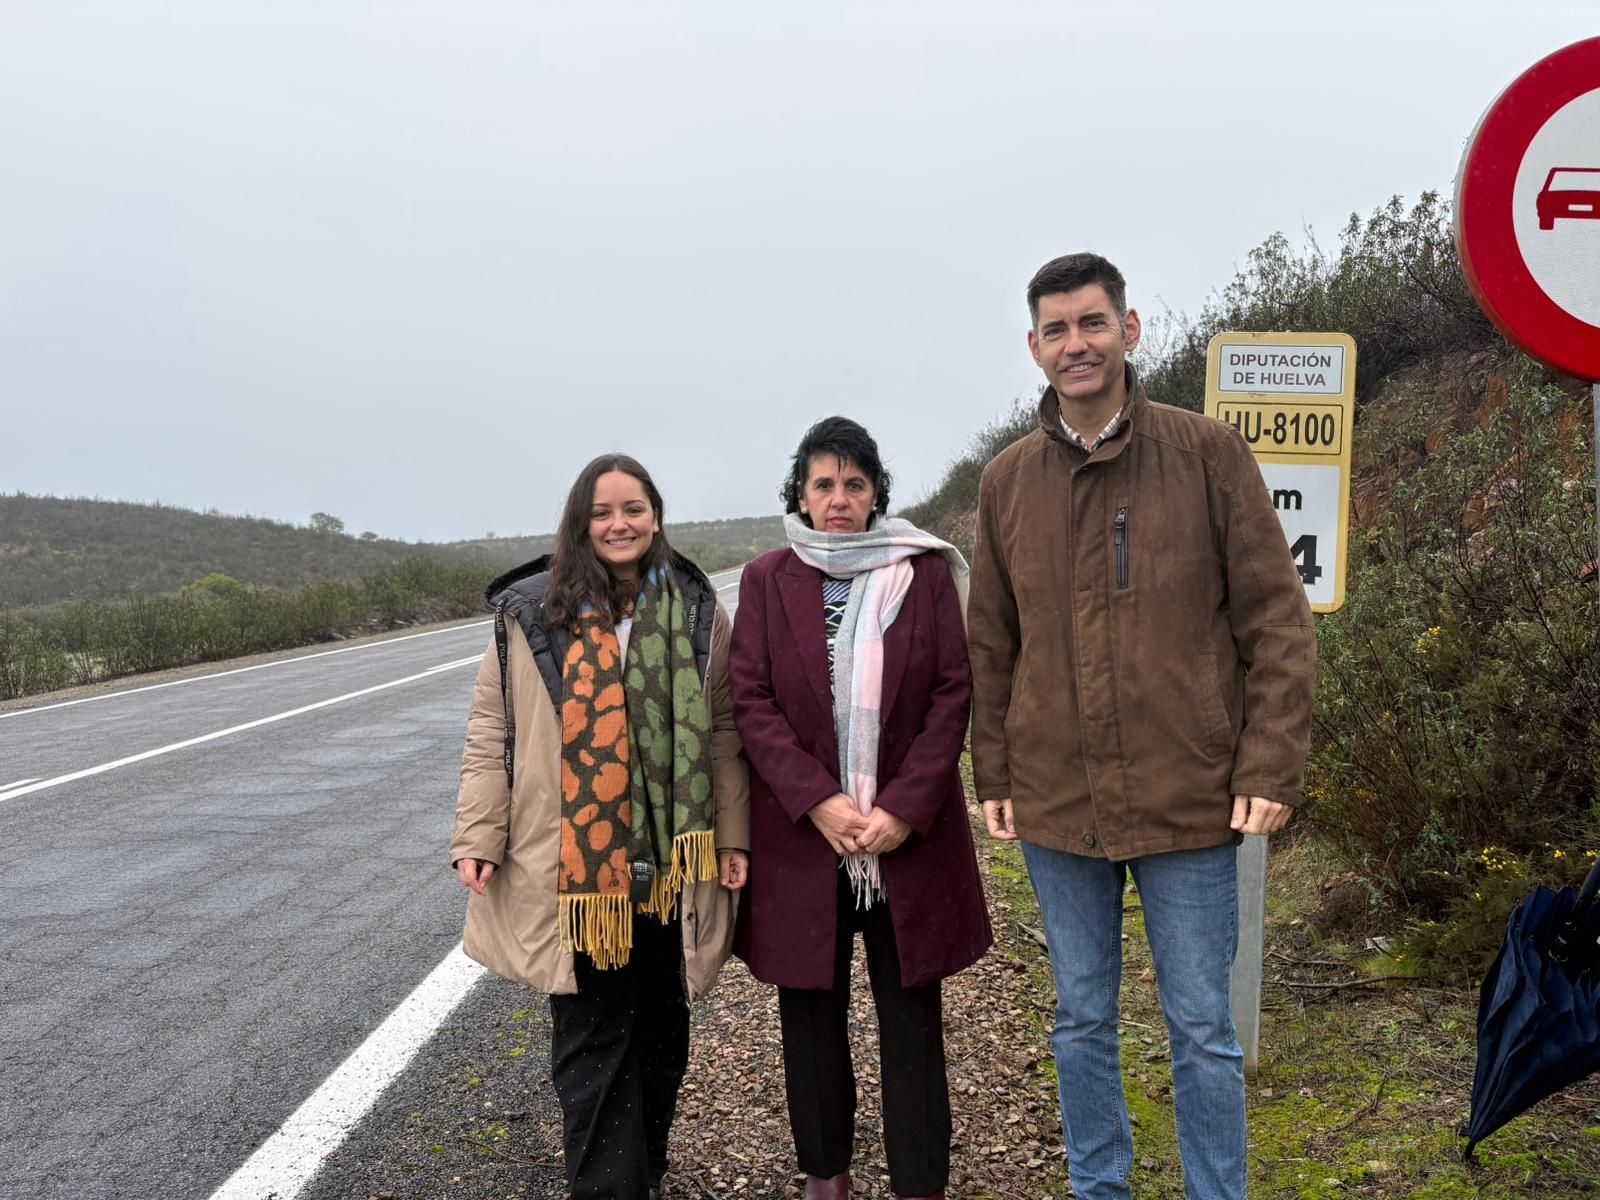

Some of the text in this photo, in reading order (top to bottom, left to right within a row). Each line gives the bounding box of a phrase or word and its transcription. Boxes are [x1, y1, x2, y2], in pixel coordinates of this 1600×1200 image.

[1230, 352, 1331, 368] DIPUTACIÓN
[1233, 372, 1326, 386] DE HUELVA
[1269, 489, 1302, 510] m
